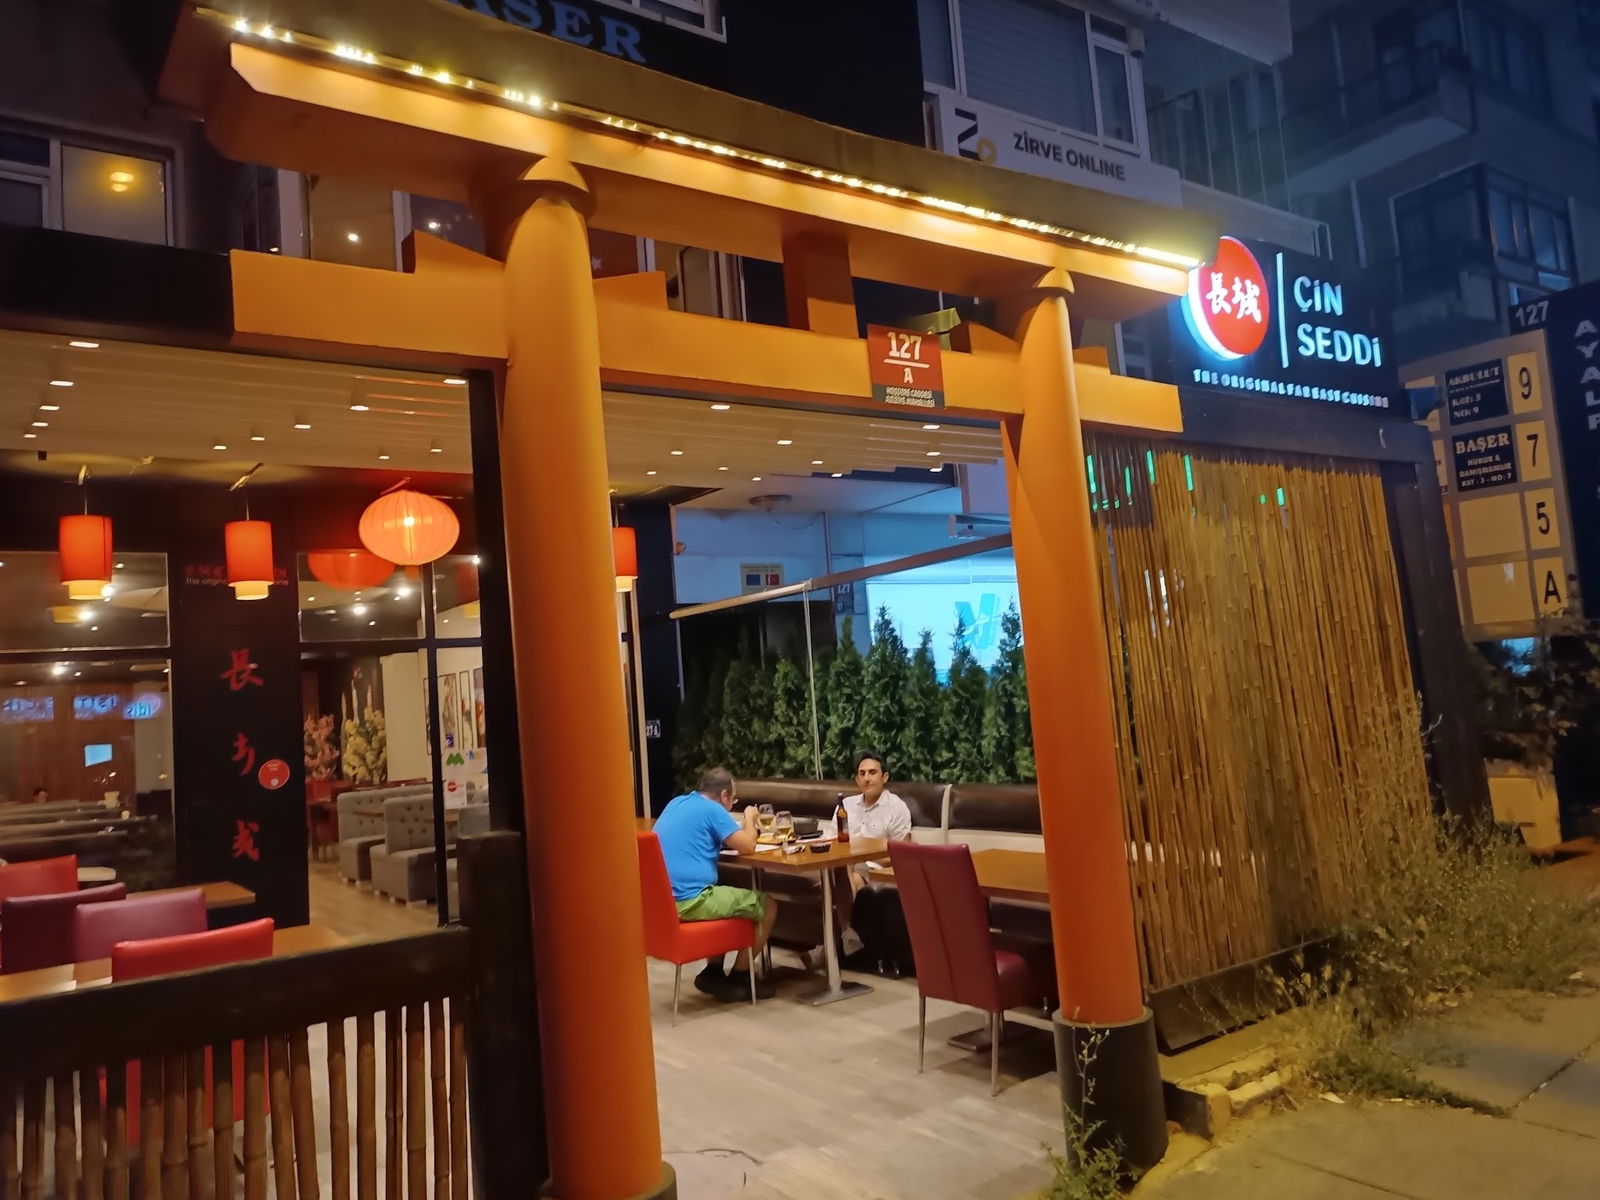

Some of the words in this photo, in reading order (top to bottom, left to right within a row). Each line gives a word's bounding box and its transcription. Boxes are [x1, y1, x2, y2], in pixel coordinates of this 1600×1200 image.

[444, 0, 646, 63] SER
[1013, 129, 1063, 163] ZİRVE
[1065, 149, 1126, 182] ONLINE
[1515, 300, 1550, 328] 127
[887, 331, 922, 361] 127
[903, 367, 914, 384] A
[1519, 366, 1532, 400] 9
[1455, 432, 1511, 454] BAŞER
[1526, 433, 1539, 467] 7
[1536, 501, 1550, 535] 5
[1543, 570, 1562, 604] A
